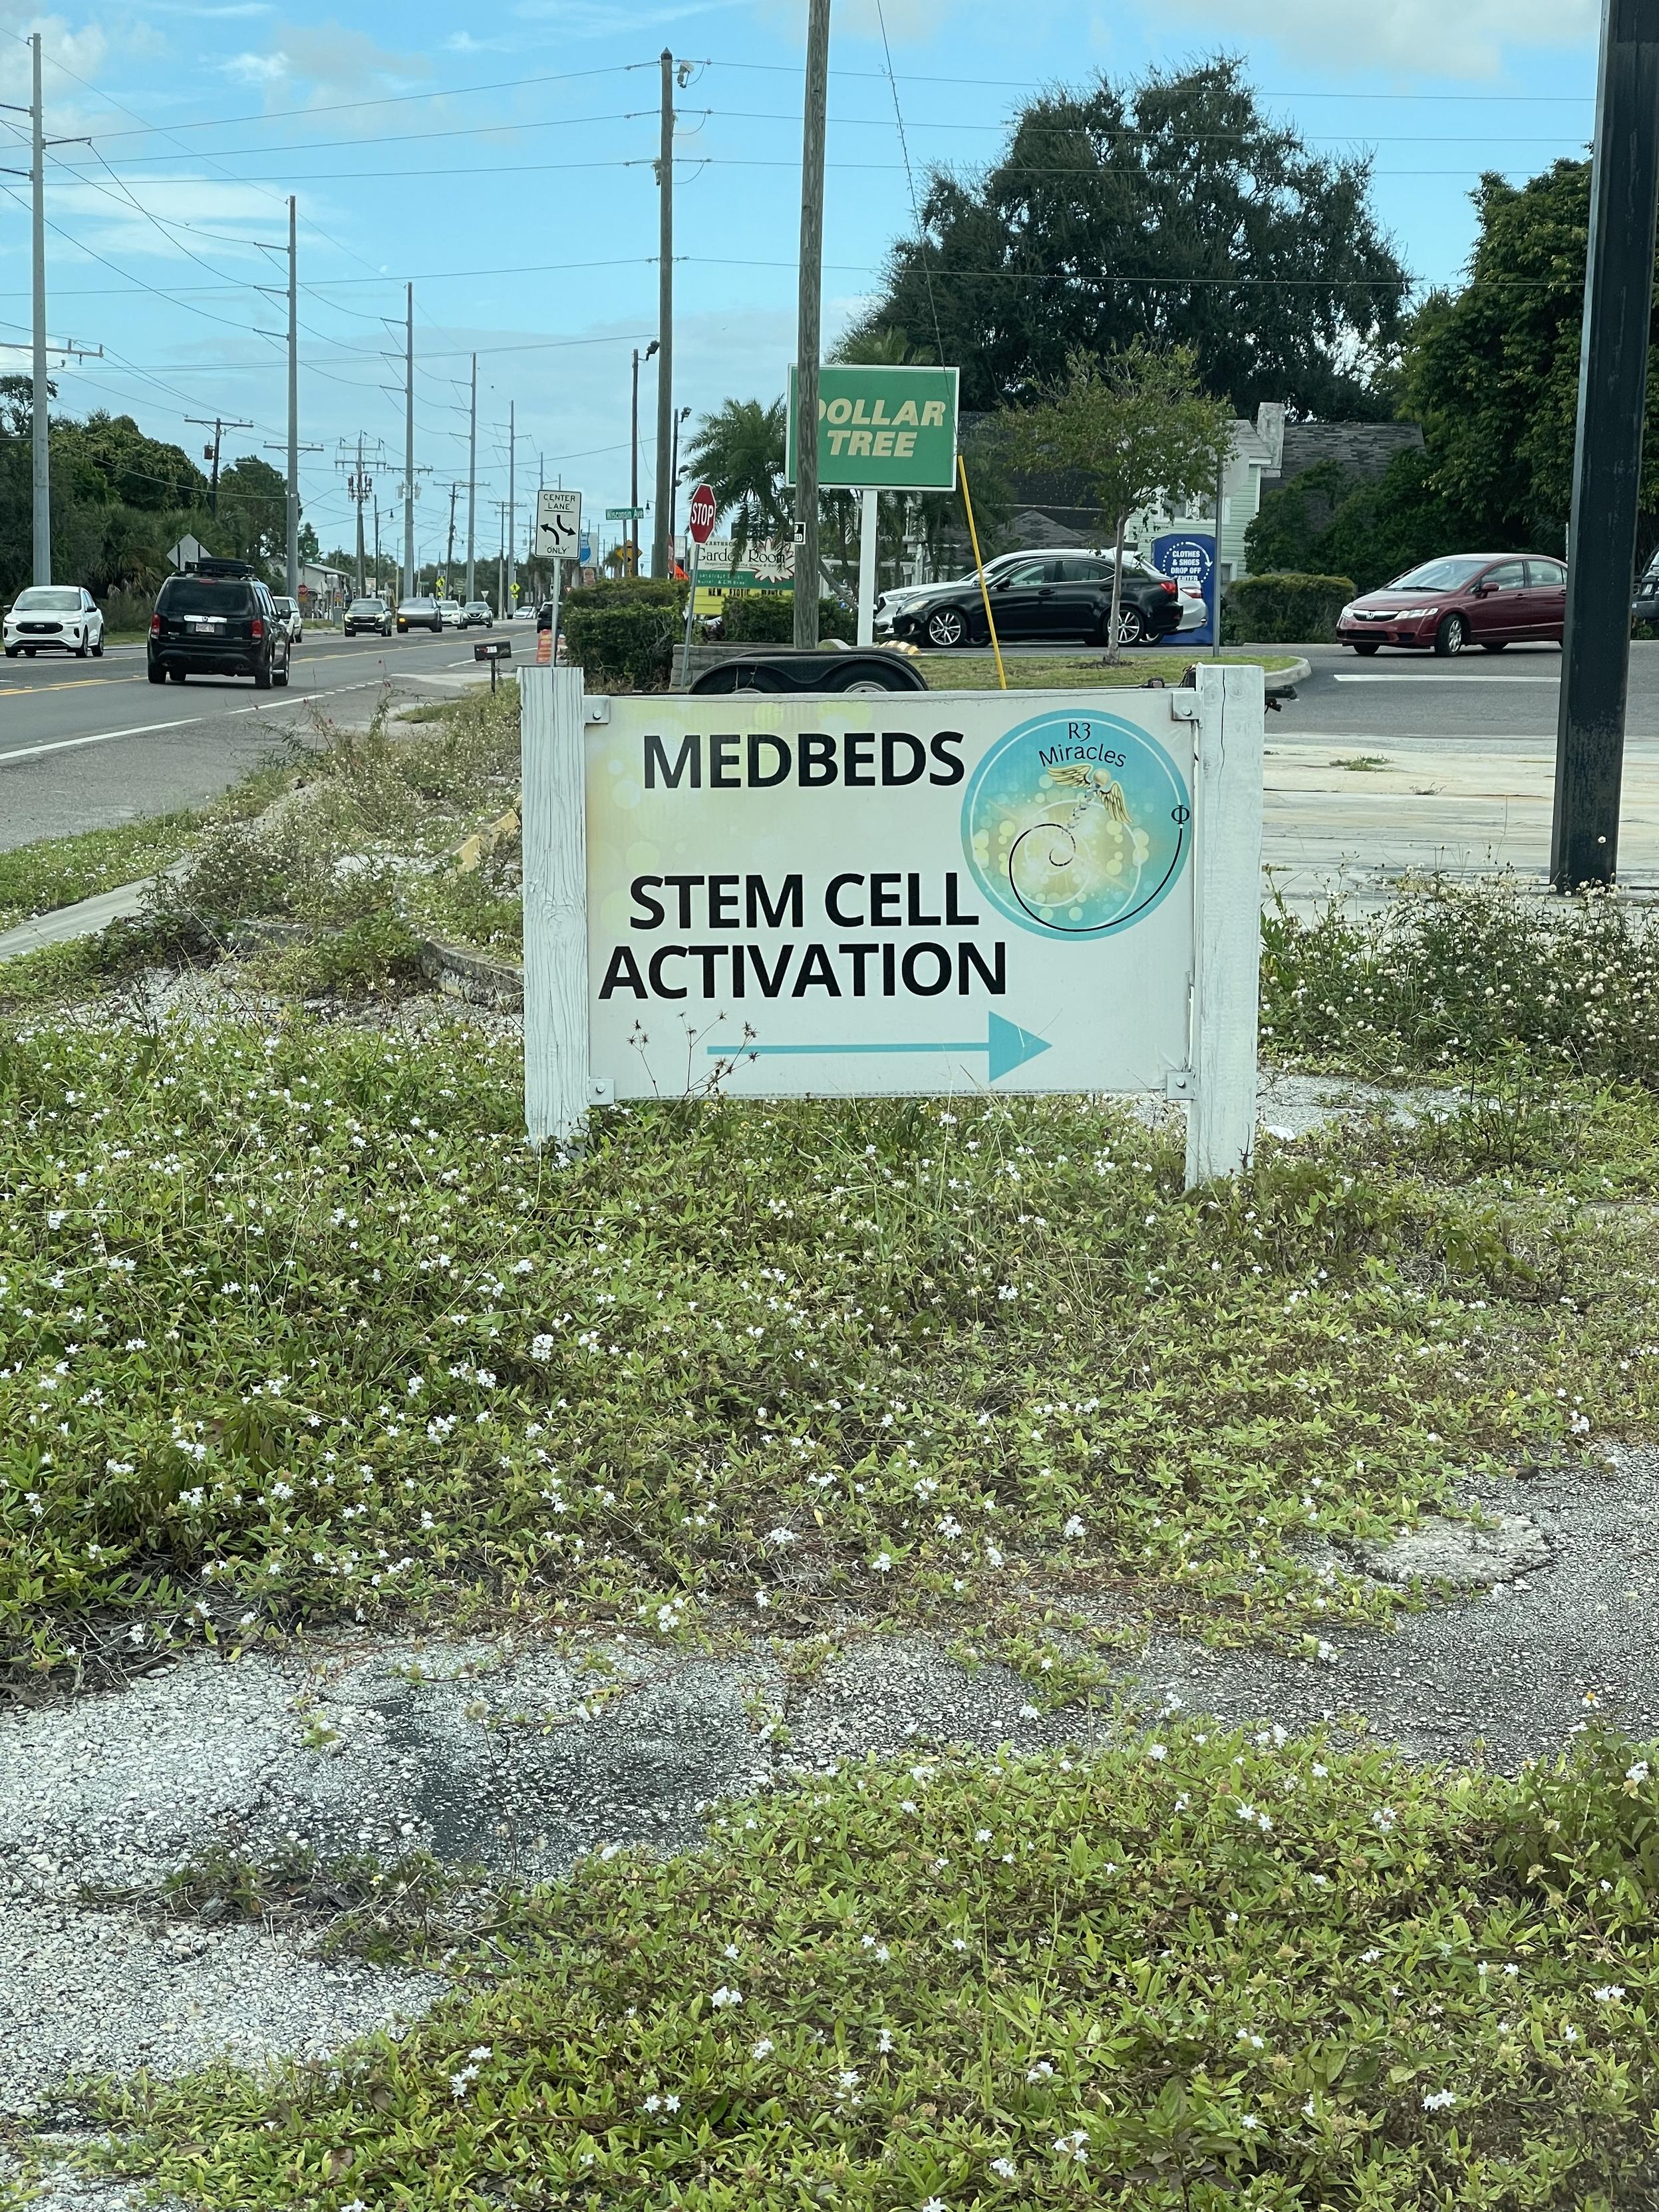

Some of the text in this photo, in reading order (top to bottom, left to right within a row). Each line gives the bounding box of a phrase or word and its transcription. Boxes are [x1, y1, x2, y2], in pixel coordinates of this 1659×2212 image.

[819, 398, 946, 426] OLLAR
[827, 430, 917, 457] TREE
[607, 509, 643, 519] Wisconsin Ave
[691, 502, 714, 526] STOP
[708, 587, 722, 596] NEW
[1068, 722, 1091, 742] R3
[644, 730, 965, 789] MEDBEDS
[1038, 743, 1127, 768] Miracles
[630, 872, 979, 930] STEM CELL
[598, 941, 1006, 1000] ACTIVATION
